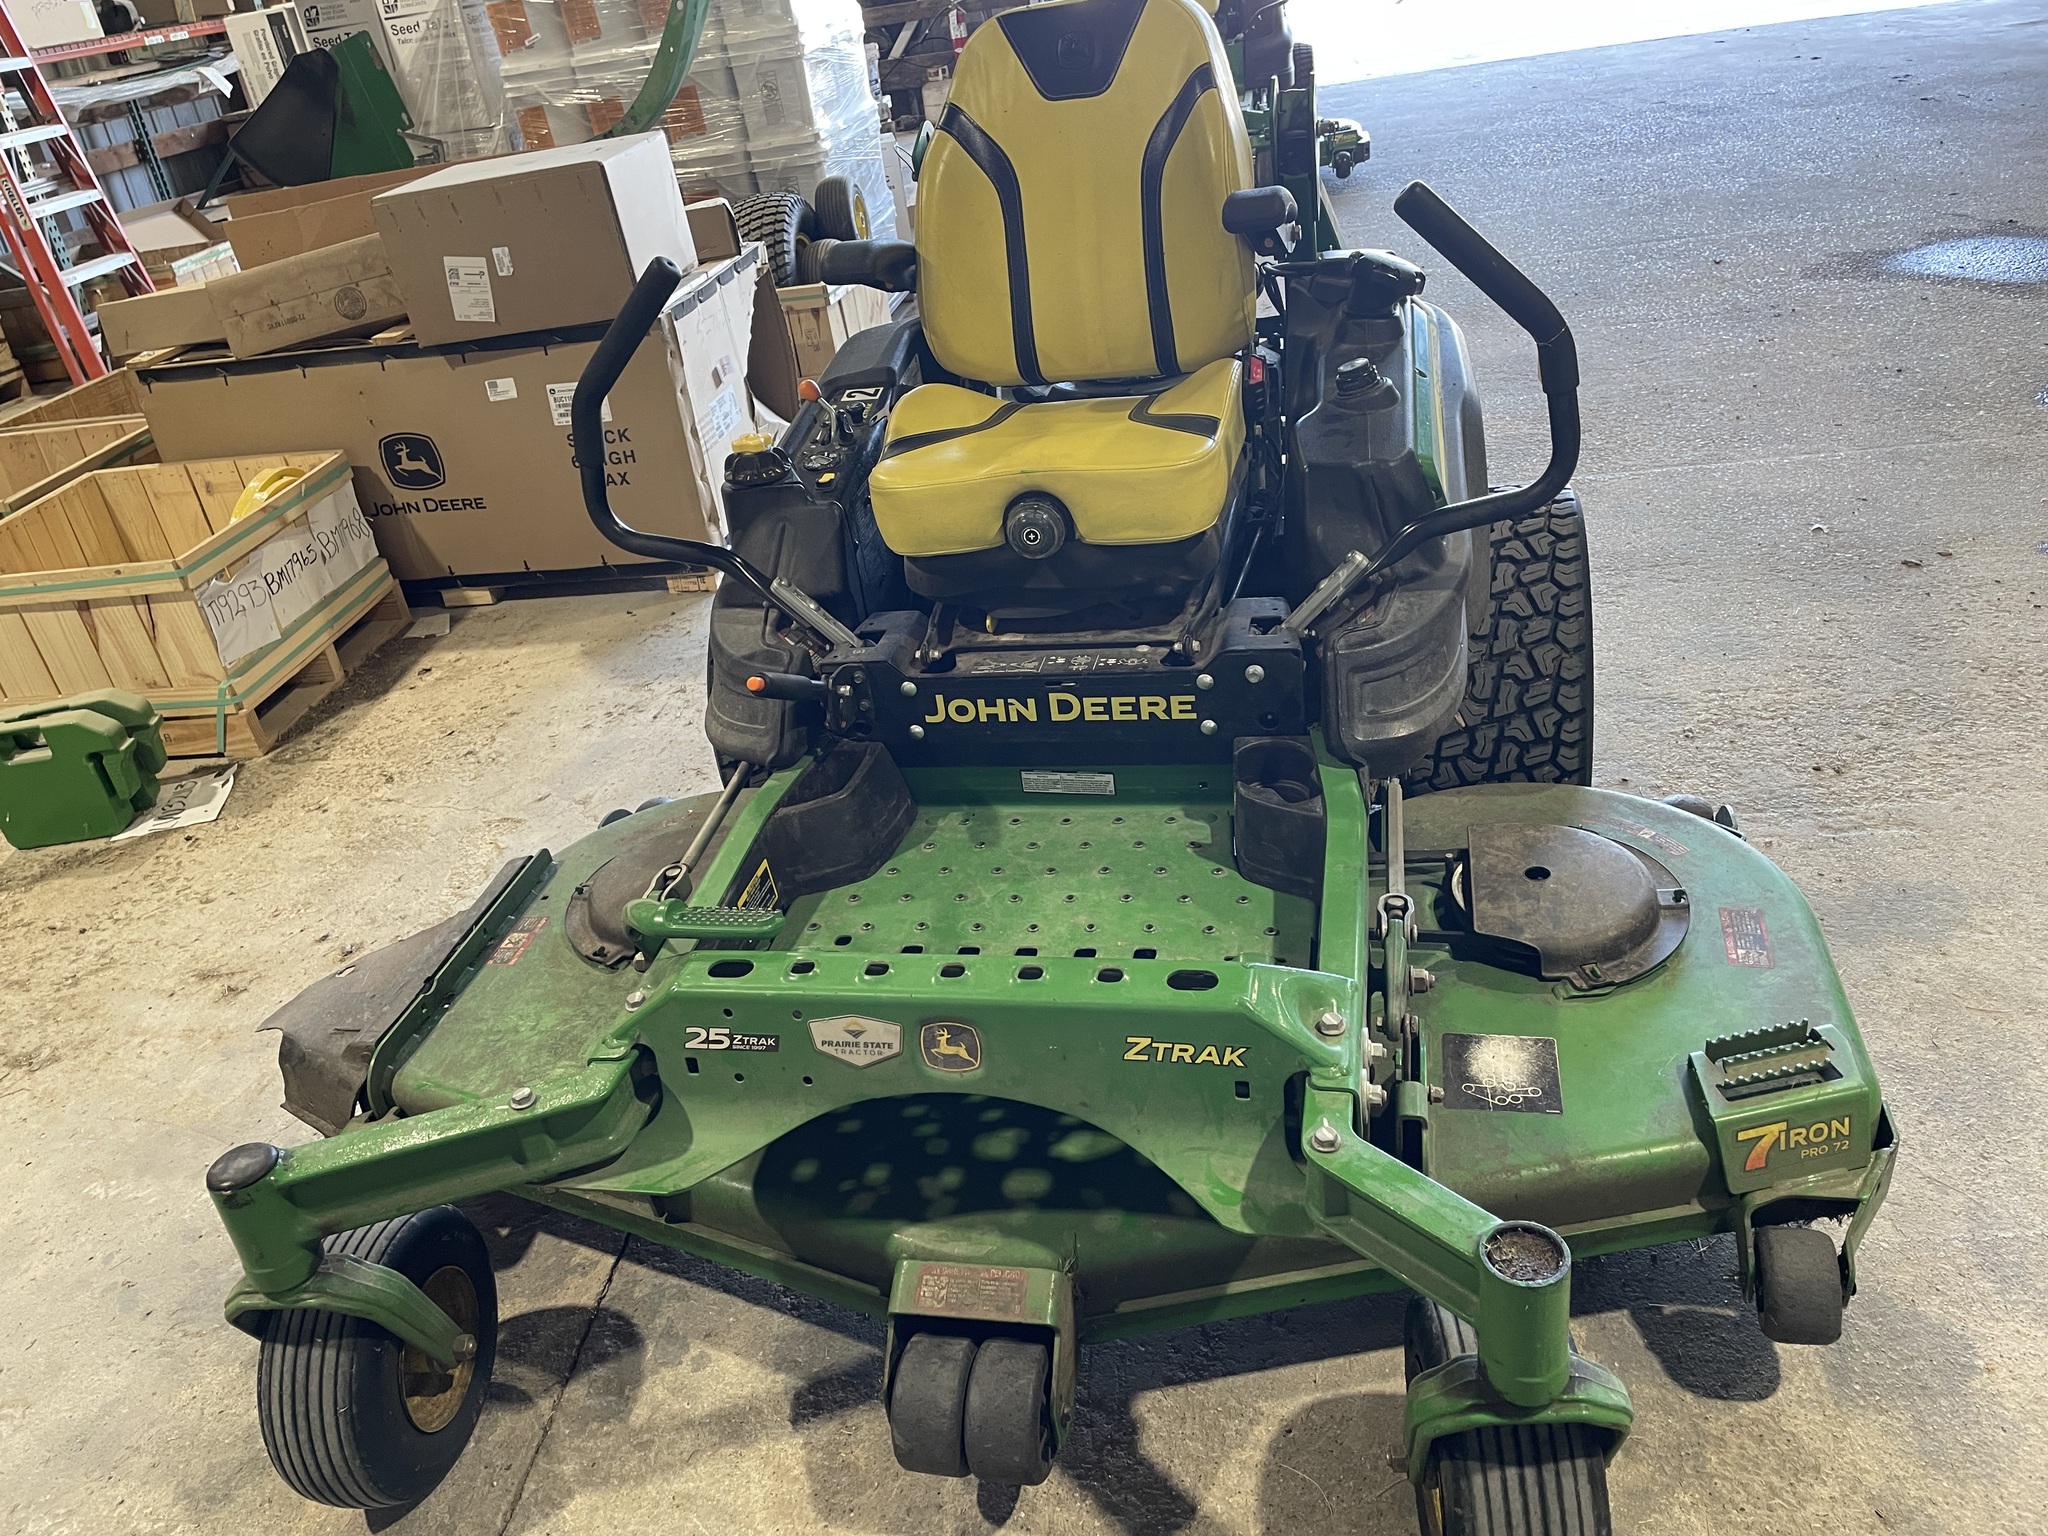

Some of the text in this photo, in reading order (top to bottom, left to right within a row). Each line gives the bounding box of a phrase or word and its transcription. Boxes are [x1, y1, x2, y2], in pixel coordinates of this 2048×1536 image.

[391, 20, 420, 36] Seed
[313, 33, 342, 49] Seed
[567, 428, 631, 447] SCK
[606, 471, 631, 486] AX
[371, 497, 487, 517] JOHN DEERE
[264, 543, 319, 596] BM17965
[925, 692, 1198, 723] JOHN DEERE
[685, 1027, 776, 1050] 25 ZTRAK
[821, 1040, 894, 1050] PRAIRIE STATE
[834, 1048, 883, 1056] TRACTOR
[1124, 1036, 1248, 1068] ZTRAK
[1801, 1141, 1850, 1159] PRO 72
